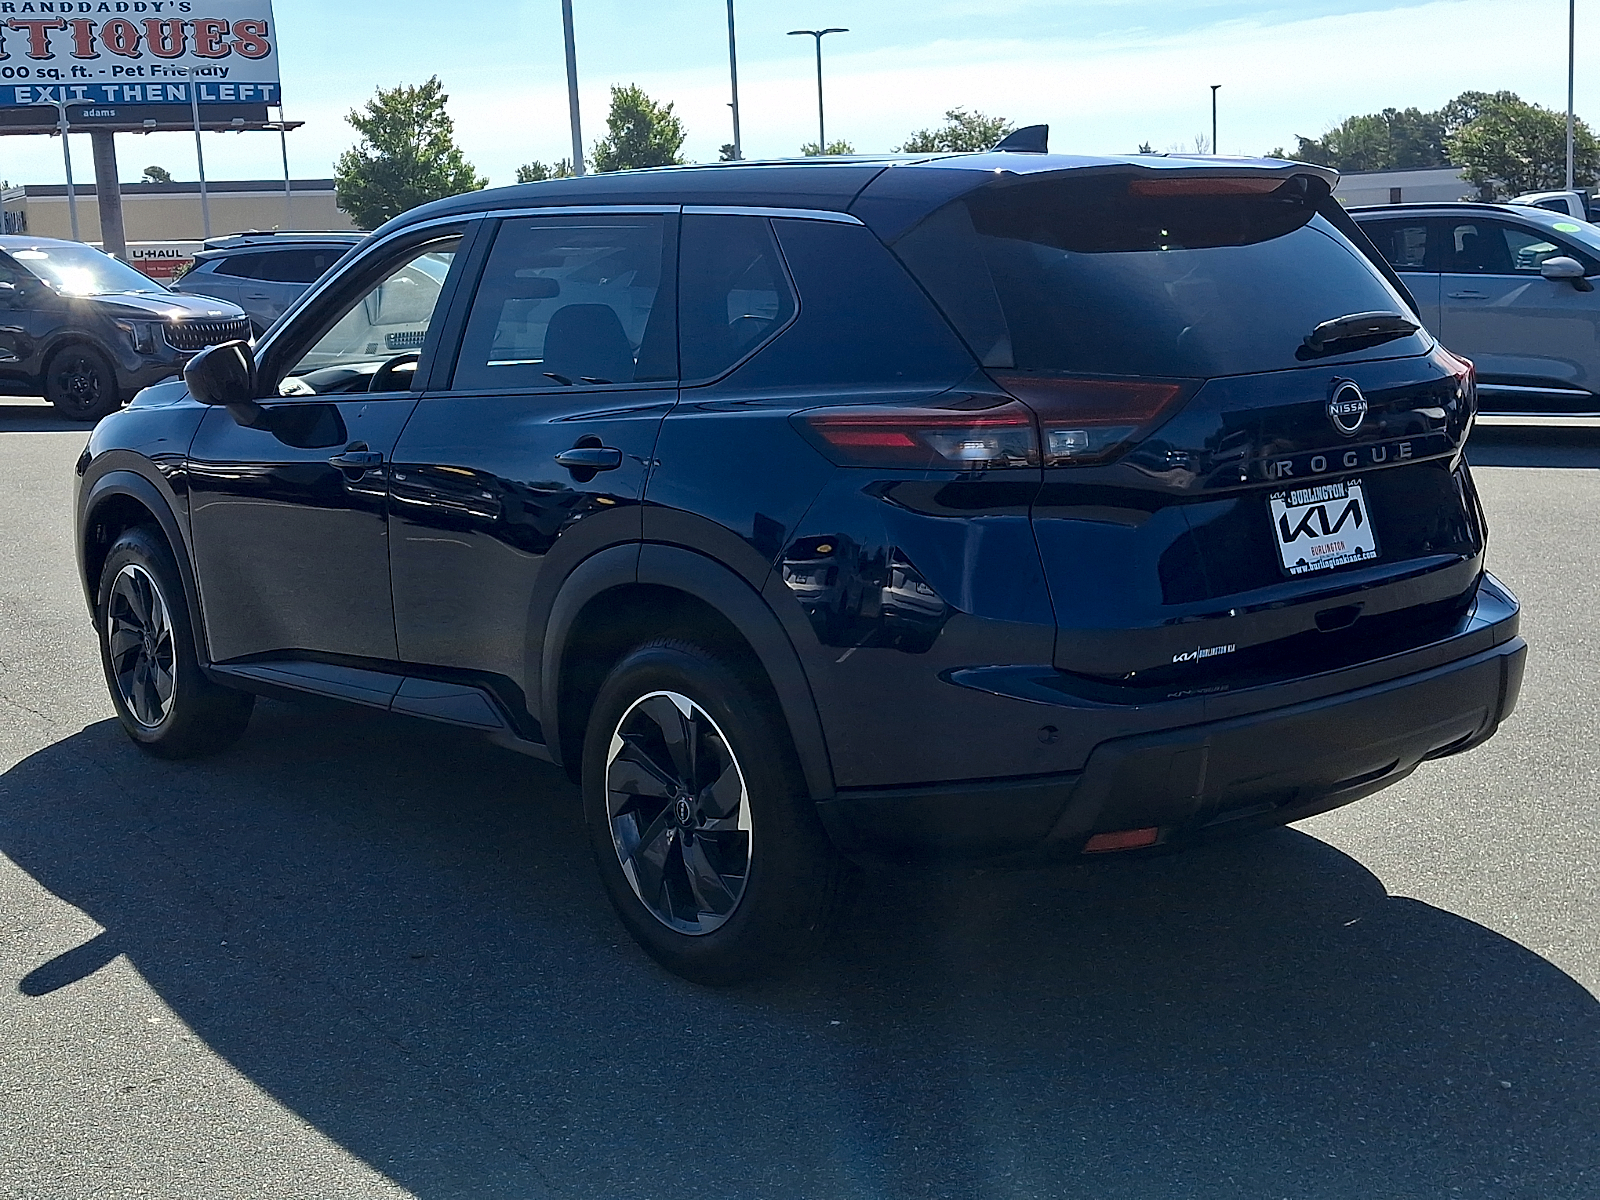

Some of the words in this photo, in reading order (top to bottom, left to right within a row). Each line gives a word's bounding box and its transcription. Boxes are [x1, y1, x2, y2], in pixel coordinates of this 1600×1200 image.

[36, 68, 66, 80] sq.
[71, 65, 93, 78] ft.
[112, 64, 145, 77] Pet
[14, 86, 88, 103] EXIT
[102, 84, 186, 102] THEN
[200, 84, 274, 101] LEFT
[83, 108, 116, 117] adams
[132, 249, 183, 258] U-HAUL
[1329, 400, 1368, 415] NISSAN
[1277, 441, 1412, 477] ROGUE
[1290, 482, 1345, 506] BURLINGTON
[1278, 499, 1364, 544] KIA
[1310, 541, 1347, 557] BURLINGTON
